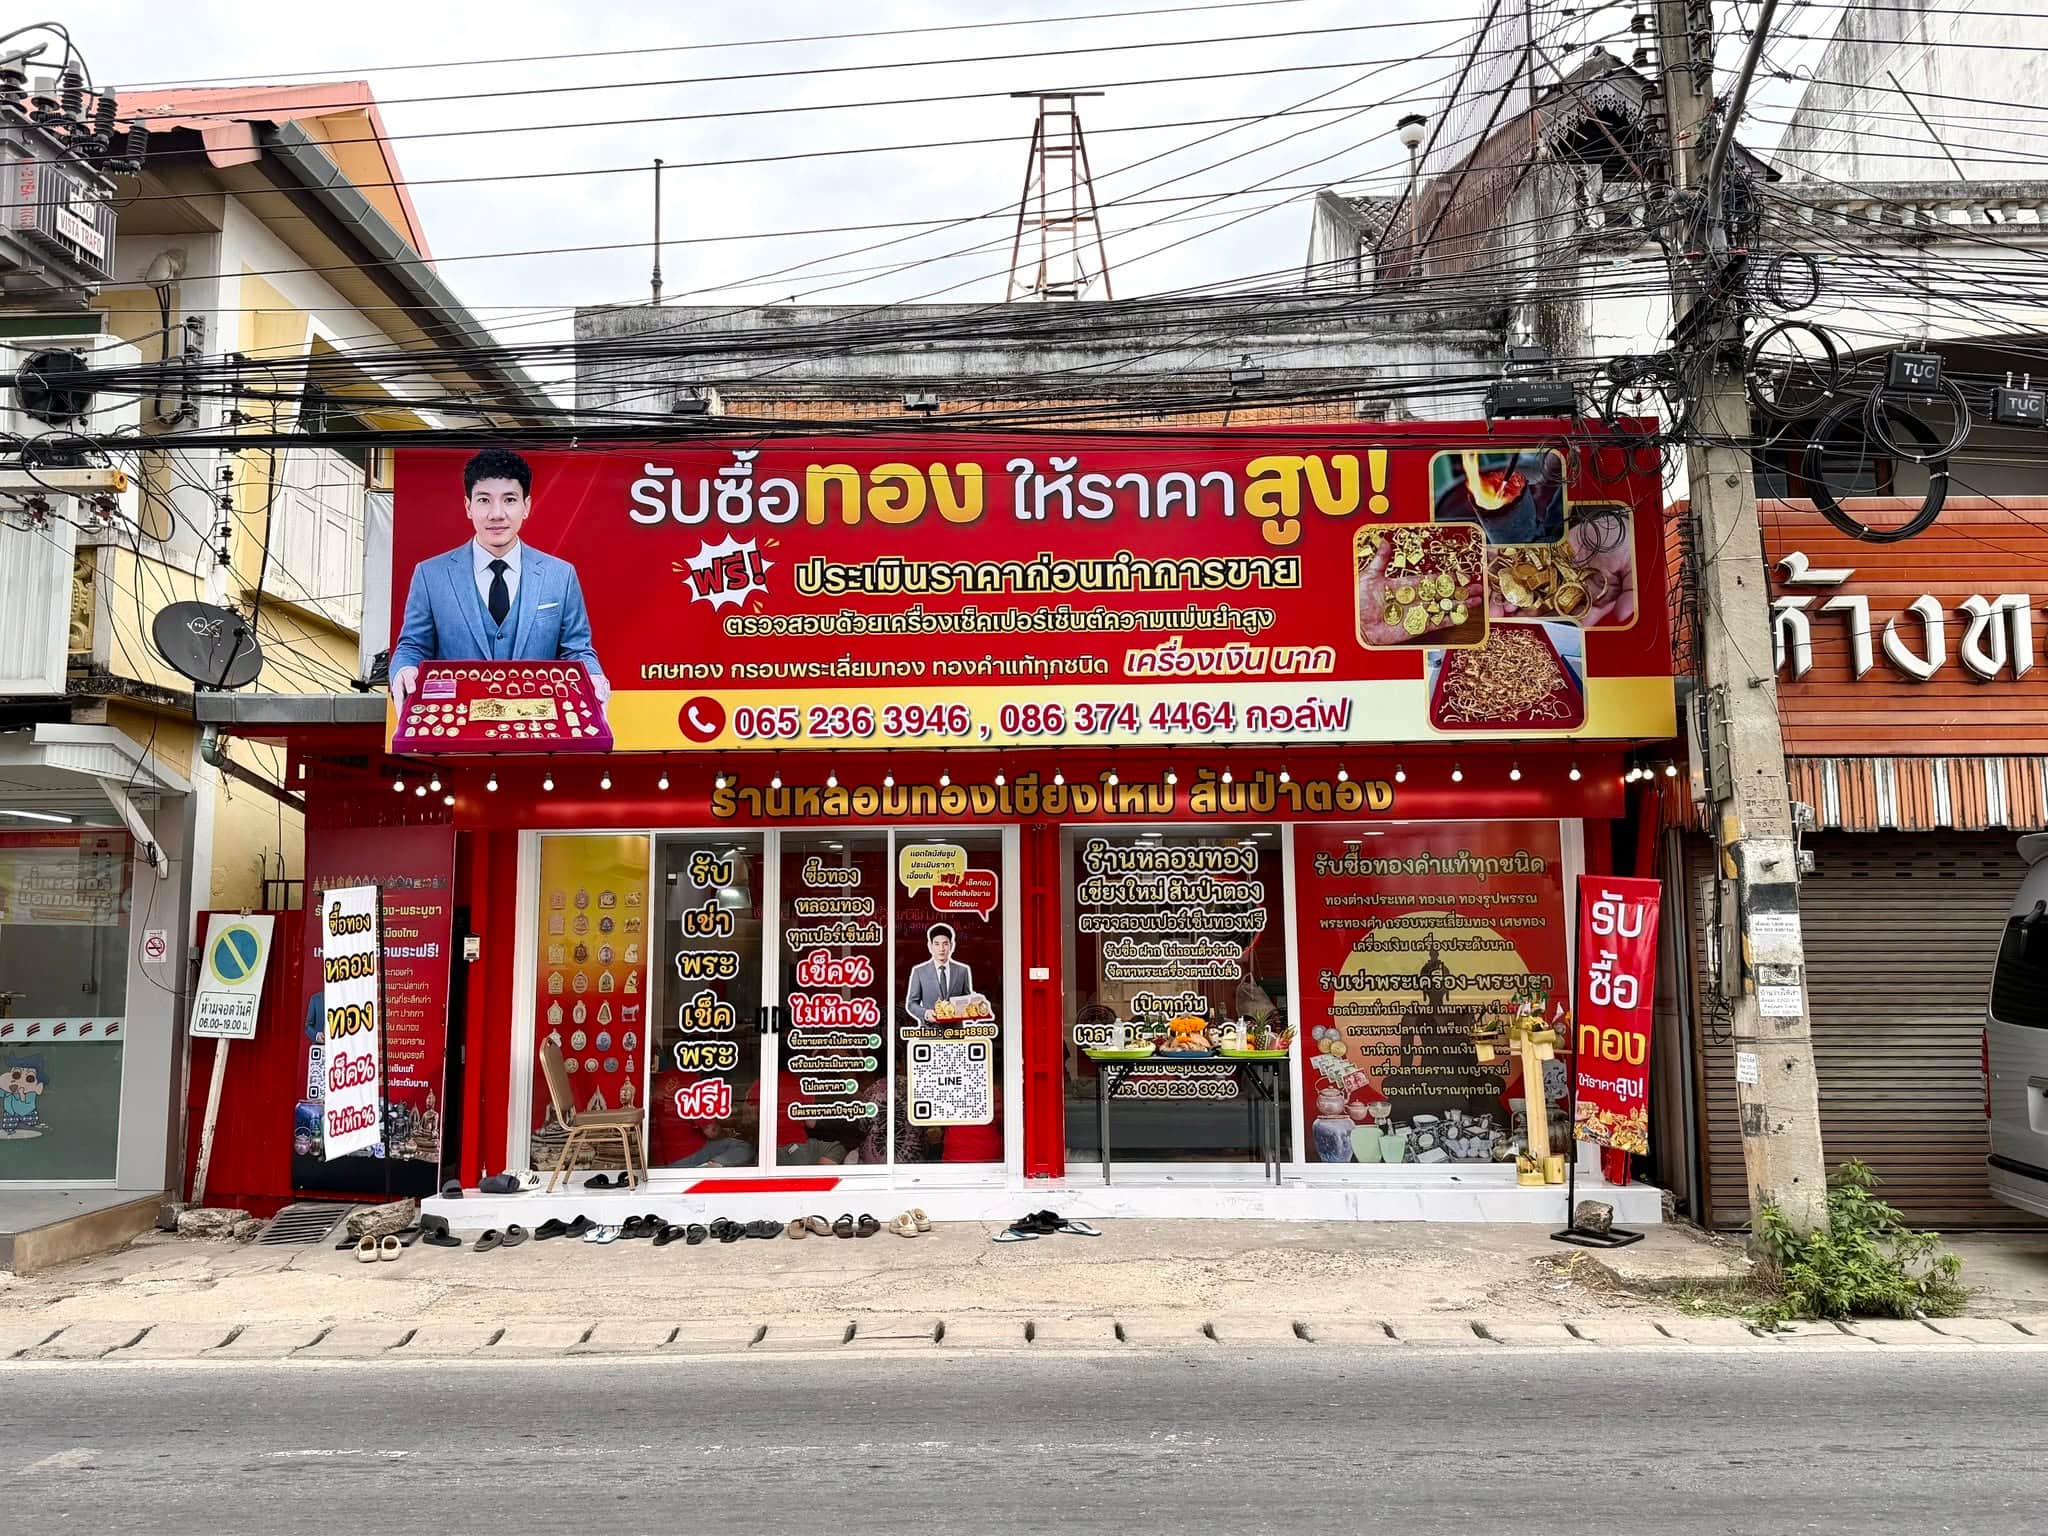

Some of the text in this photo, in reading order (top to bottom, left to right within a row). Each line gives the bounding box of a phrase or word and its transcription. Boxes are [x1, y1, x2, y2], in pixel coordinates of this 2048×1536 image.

[60, 212, 102, 253] VISTA TRAFO
[1904, 363, 1936, 378] TUC
[2009, 397, 2040, 411] TUC
[1006, 446, 1390, 545] ให้ราคาสูง!
[691, 550, 766, 596] ฟรี!
[796, 551, 1301, 594] ประเมินราคาก่อนทำการขาย
[641, 638, 1335, 681] เศษทอง กรอบพระเลี่ยมทอง ทองคำแท้ทุกชนิด เครื่องเงิน นาก
[735, 706, 799, 738] 065
[808, 704, 872, 737] 236
[883, 702, 970, 736] 3946
[1000, 702, 1064, 735] 086
[1073, 701, 1138, 734] 374
[1148, 699, 1235, 733] 4464
[1245, 696, 1354, 731] กอล์ฟ
[1190, 767, 1395, 815] สันป่าตอง
[690, 853, 732, 886] รับ
[1086, 841, 1255, 871] ร้านหลอมทอง
[1313, 844, 1545, 881] รับซื้อทองคำแท้ทุกชนิด
[804, 859, 858, 884] ซื้อทอง
[1080, 876, 1261, 901] เชียงใหม่ สันป่าตอง
[1325, 892, 1538, 909] ทองต่างประเทศ ทองเค ทองรูปพรรณ
[329, 902, 371, 935] ซื้อทอง
[685, 905, 732, 935] เช่า
[798, 900, 872, 913] หลอมทอง
[1080, 910, 1265, 931] ตรวจสอบเปอร์เซ็นทองฟรี
[1318, 915, 1381, 928] พระทองคำ
[1500, 916, 1546, 927] เศษทอง
[1592, 890, 1643, 938] รับ
[1105, 940, 1137, 956] รับซื้อ
[1352, 933, 1514, 951] เครื่องเงิน เครื่องประดับนาก
[325, 952, 375, 982] หลอม
[679, 954, 737, 978] พระ
[799, 953, 872, 984] เช็ค%
[1589, 951, 1638, 1009] ซื้อ
[328, 1001, 374, 1039] ทอง
[682, 994, 734, 1029] เช็ค
[792, 998, 878, 1025] ไม่หัก%
[1134, 994, 1205, 1016] เปิดทุกวัน
[1327, 1001, 1434, 1015] ยอดนิยมทั่วเมืองไทย
[199, 1017, 241, 1030] 06.00-19.00
[1347, 1023, 1432, 1036] กระเพาะปลาเก่า
[679, 1045, 735, 1069] พระ
[1403, 1043, 1439, 1055] ปากกา
[1579, 1024, 1645, 1065] ทอง
[329, 1052, 375, 1092] เช็ค%
[938, 1076, 962, 1086] LINE
[1371, 1059, 1510, 1076] เครื่องลายคราม เบญจรงค์
[679, 1081, 731, 1116] ฟรี!
[1139, 1083, 1166, 1095] 065
[1169, 1083, 1196, 1095] 236
[1199, 1083, 1236, 1095] 3946
[1383, 1083, 1501, 1098] ของเก่าโบราณทุกชนิด
[1578, 1073, 1644, 1103] ให้ราคาสูง!
[328, 1104, 376, 1137] ไม่หัก%
